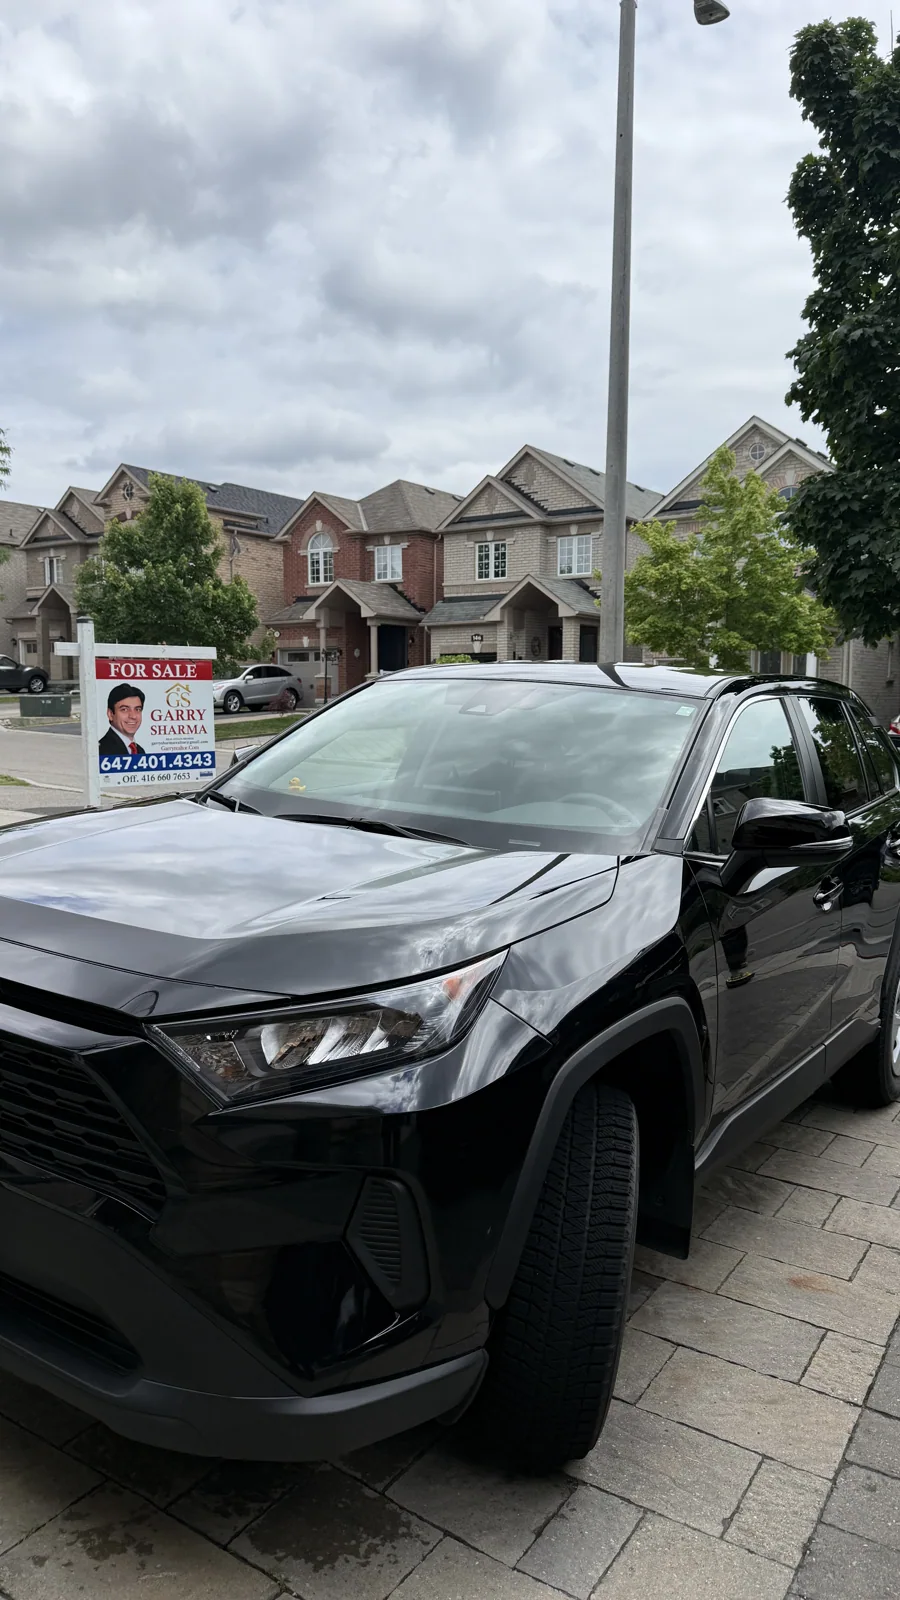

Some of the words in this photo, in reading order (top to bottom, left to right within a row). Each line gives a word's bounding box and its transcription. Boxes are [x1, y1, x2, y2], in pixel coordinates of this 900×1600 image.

[109, 663, 148, 677] FOR
[152, 664, 197, 678] SALE
[166, 691, 191, 708] GS
[150, 709, 206, 721] GARRY
[150, 725, 207, 735] SHARMA
[100, 753, 212, 770] 647.401.4343
[122, 775, 139, 783] Off.
[141, 774, 156, 782] 416
[157, 773, 171, 781] 660
[173, 772, 191, 780] 7653
